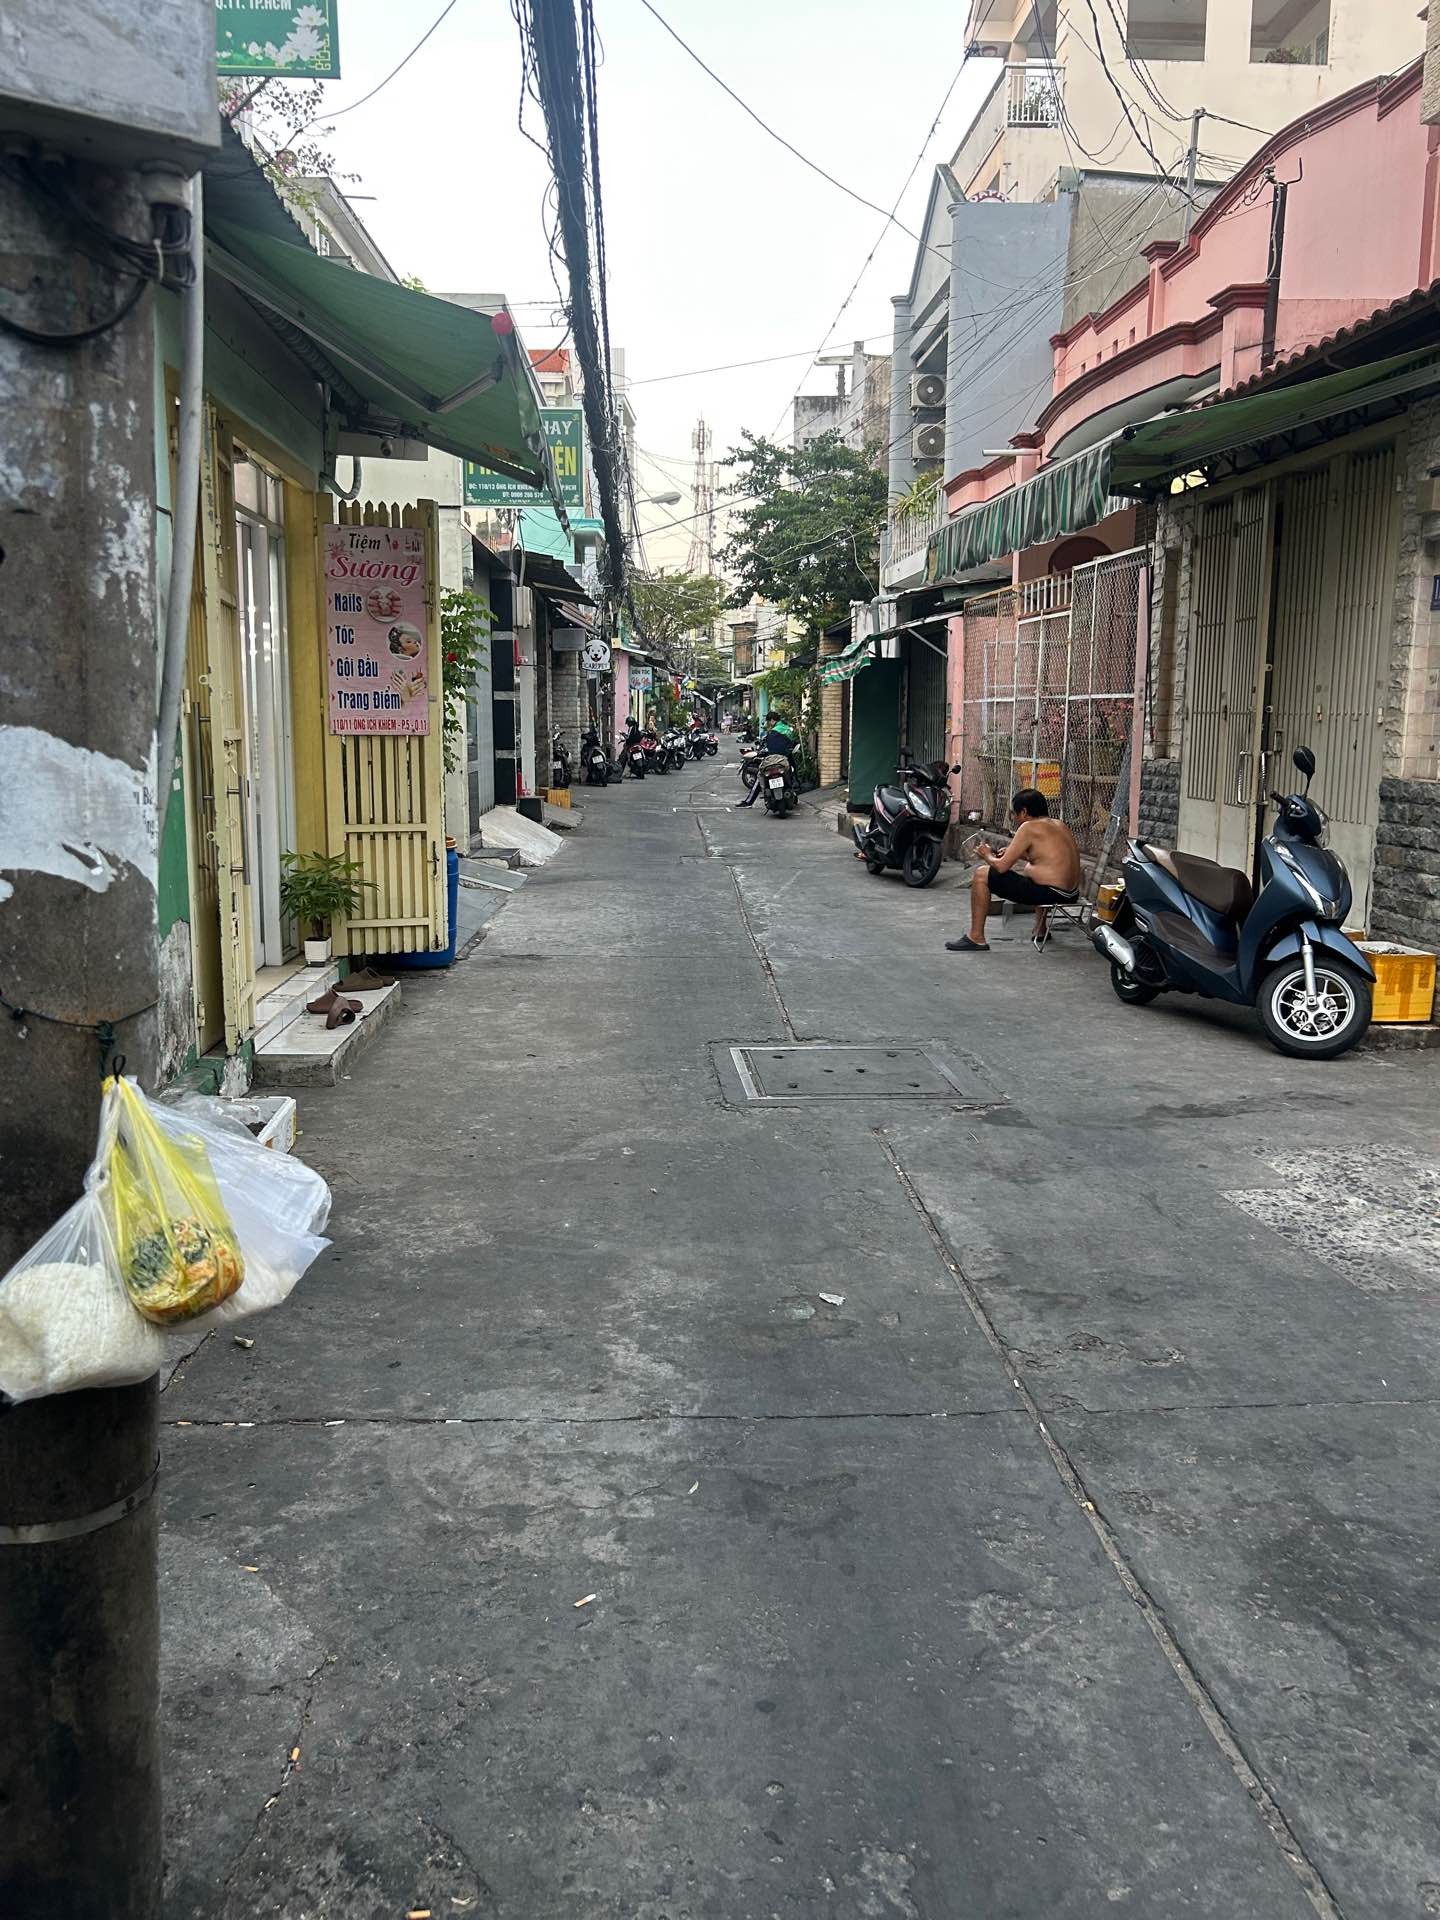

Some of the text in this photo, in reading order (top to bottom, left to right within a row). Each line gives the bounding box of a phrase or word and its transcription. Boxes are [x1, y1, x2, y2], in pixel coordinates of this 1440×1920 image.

[349, 533, 380, 554] Tiệm
[330, 556, 418, 587] Sương
[334, 592, 362, 613] Nails
[335, 624, 354, 645] Tóc
[336, 653, 378, 681] Gội Đầu
[337, 685, 401, 711] Trang Điểm
[401, 719, 410, 730] P.5
